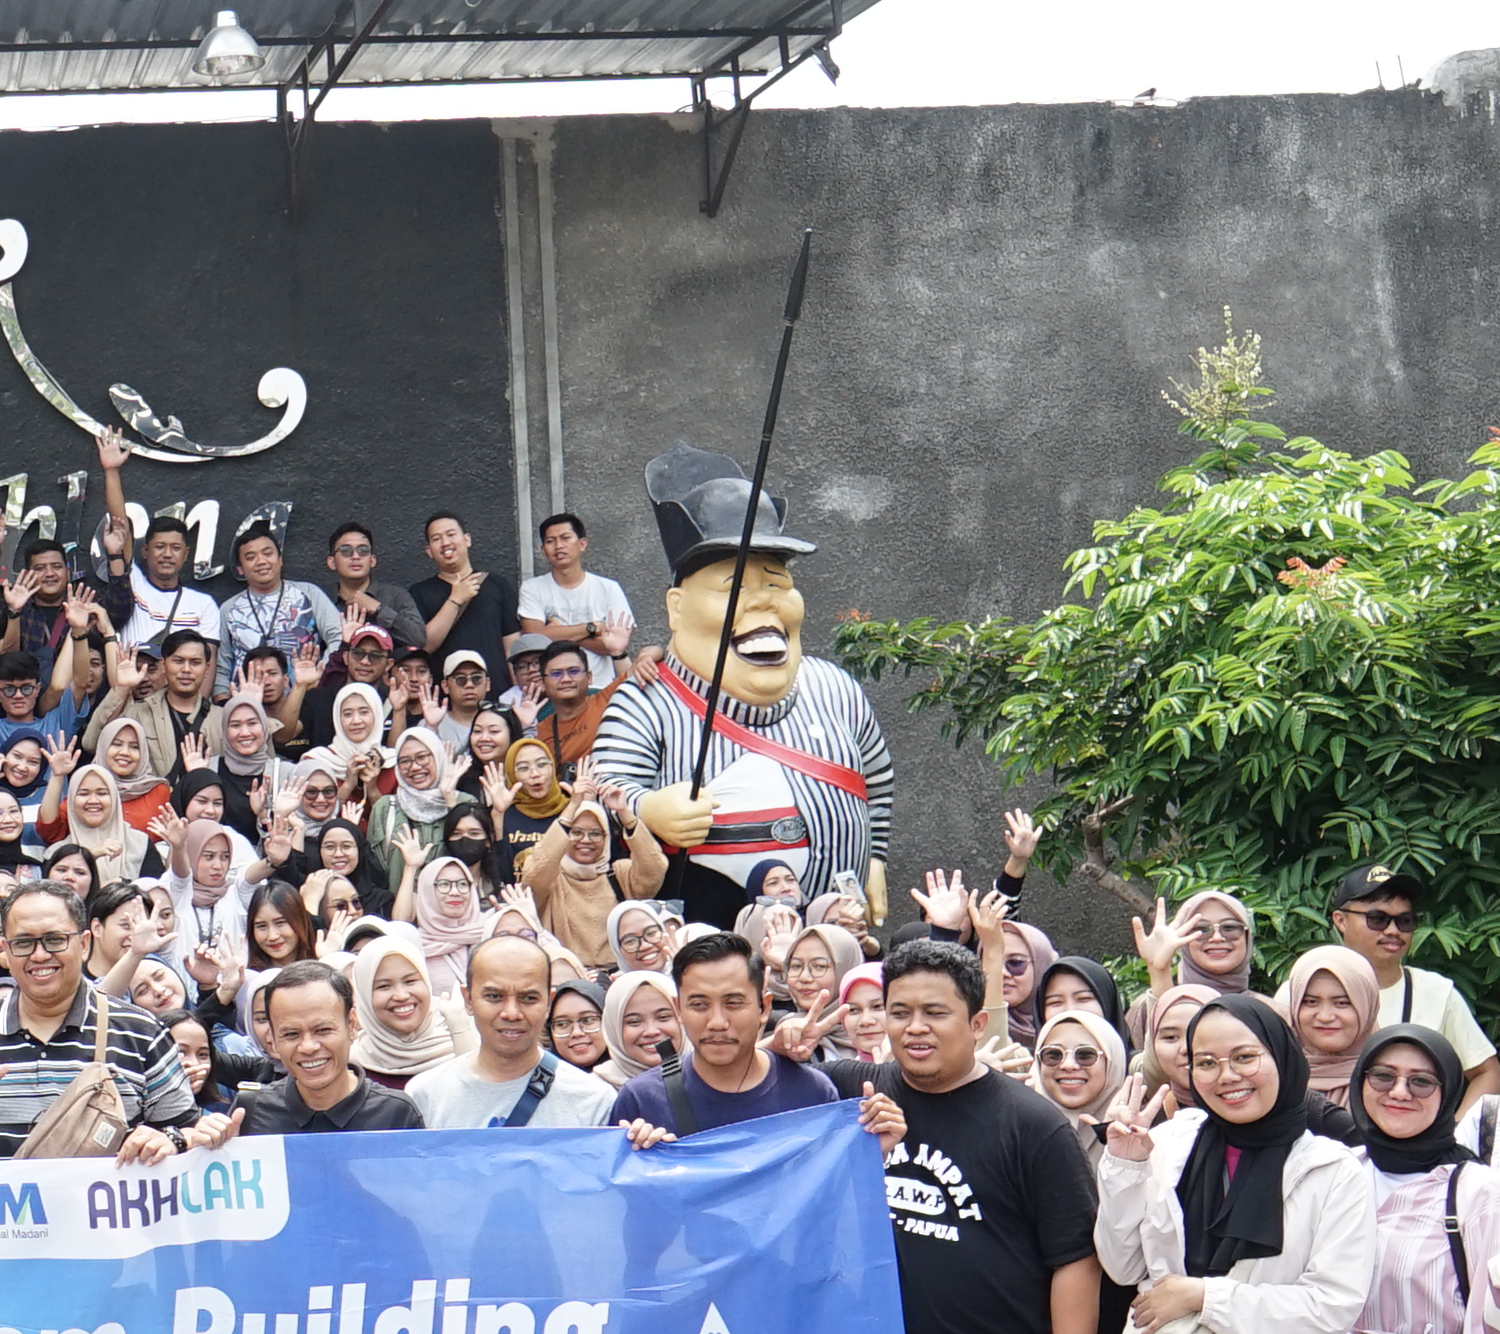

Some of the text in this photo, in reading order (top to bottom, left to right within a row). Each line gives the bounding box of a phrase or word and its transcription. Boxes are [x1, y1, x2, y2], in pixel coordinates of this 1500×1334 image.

[87, 1159, 265, 1230] AKHLAK
[913, 1143, 983, 1222] AMPAT
[12, 1228, 49, 1239] Madani
